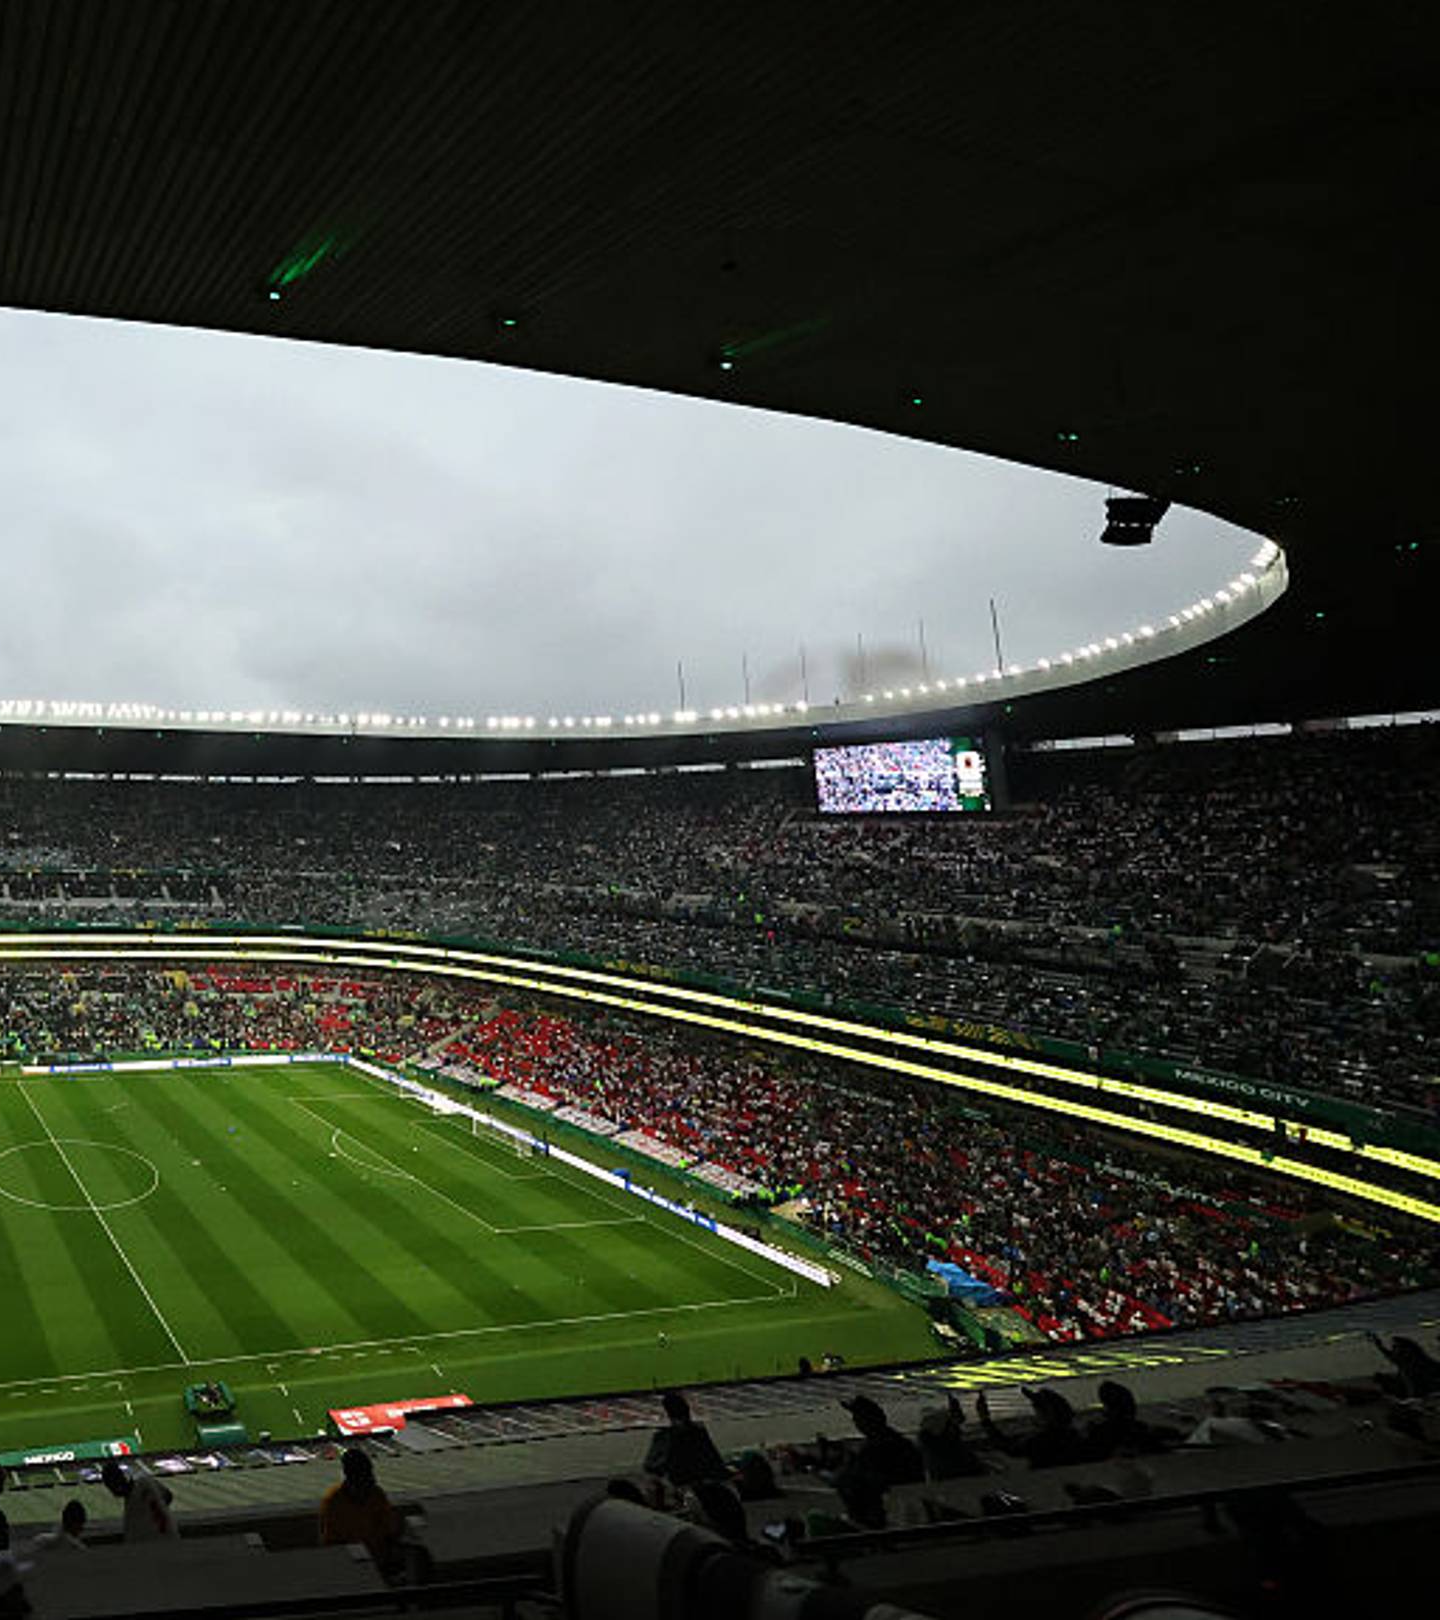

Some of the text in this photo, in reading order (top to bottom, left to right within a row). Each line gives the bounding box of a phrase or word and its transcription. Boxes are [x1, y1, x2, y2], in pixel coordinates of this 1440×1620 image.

[1174, 1068, 1310, 1107] MEXICO CITY
[23, 1451, 75, 1464] MEXICO
